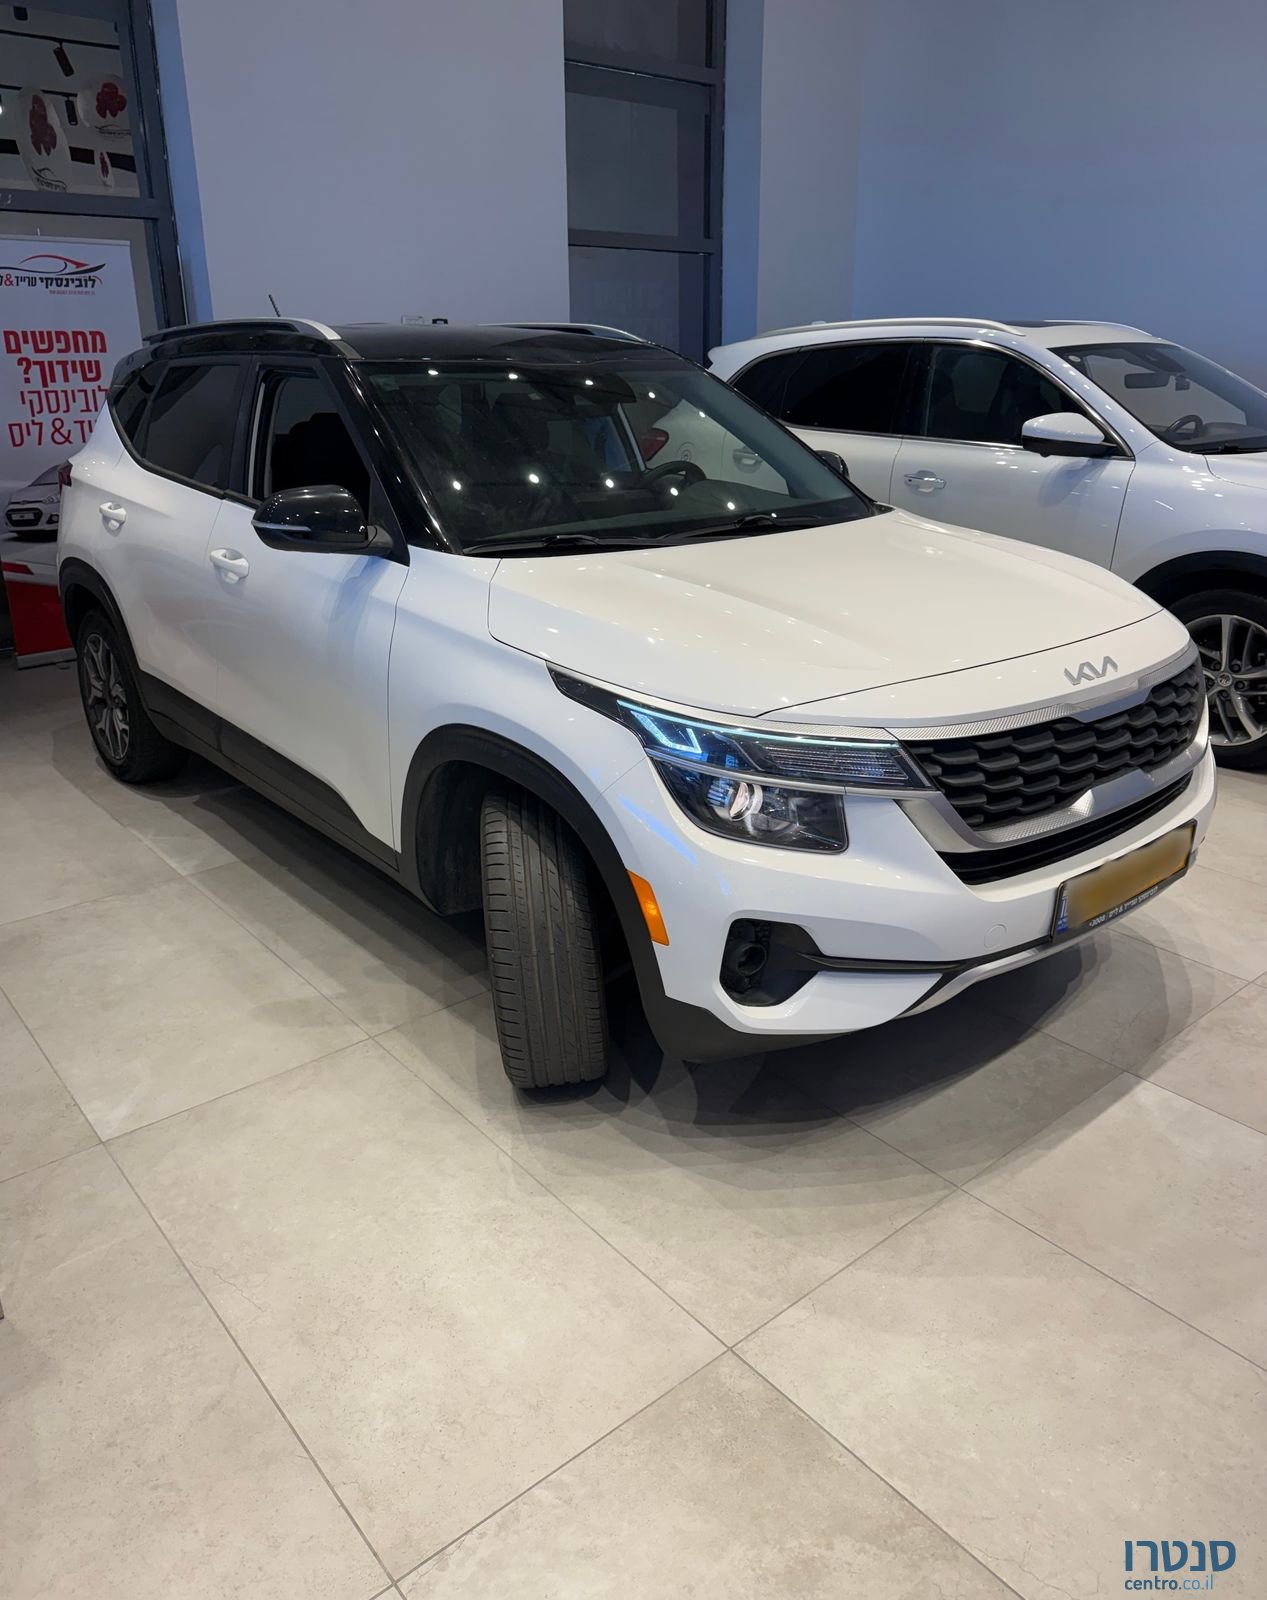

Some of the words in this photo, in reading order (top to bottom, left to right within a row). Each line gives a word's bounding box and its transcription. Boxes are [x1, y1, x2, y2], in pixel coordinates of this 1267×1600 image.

[39, 275, 97, 289] לובינסקי
[3, 330, 107, 354] מחפשים
[17, 357, 102, 388] שידוך?
[8, 419, 43, 448] ליס
[51, 418, 73, 445] &
